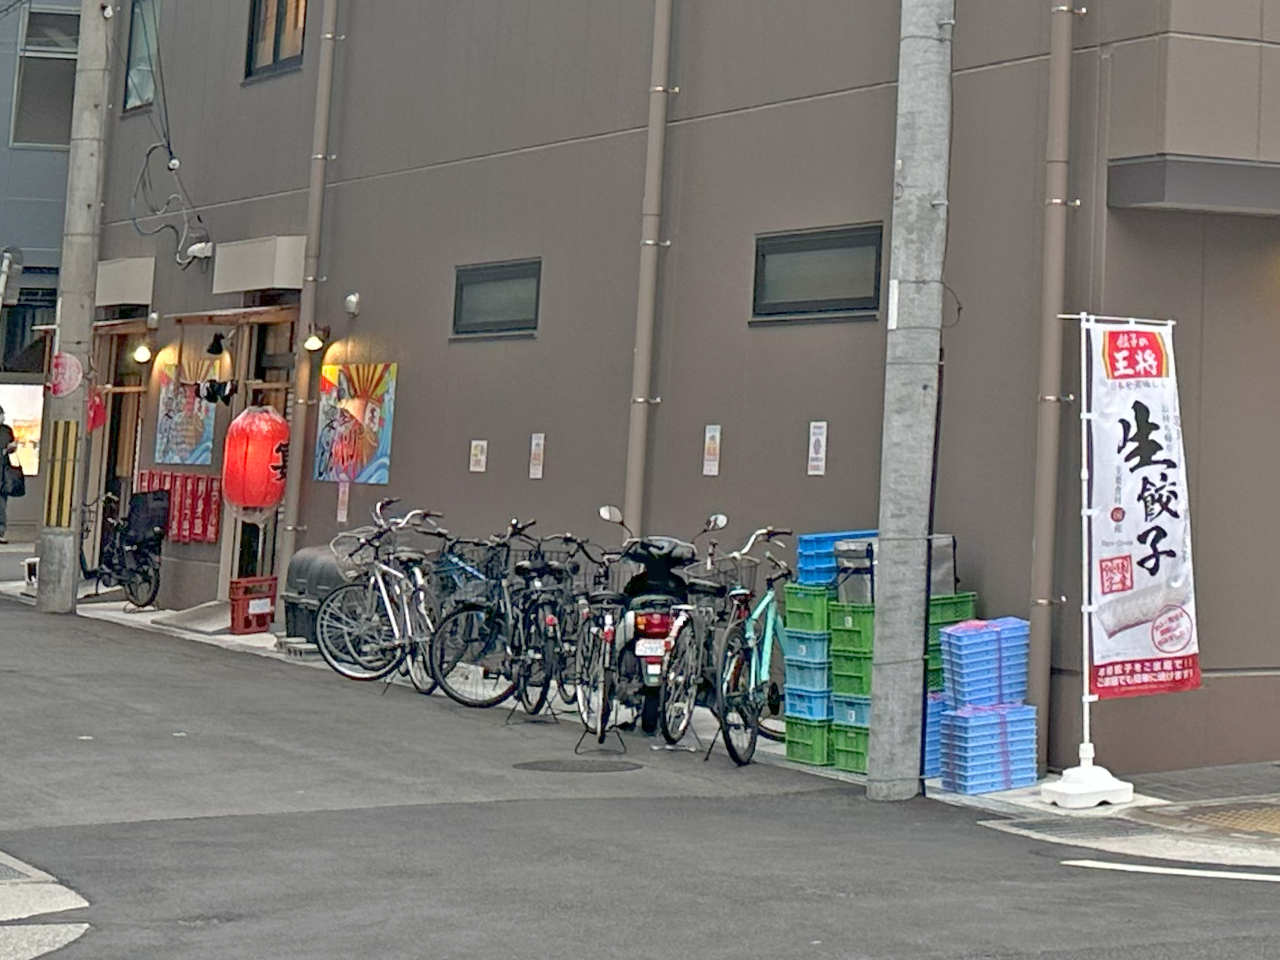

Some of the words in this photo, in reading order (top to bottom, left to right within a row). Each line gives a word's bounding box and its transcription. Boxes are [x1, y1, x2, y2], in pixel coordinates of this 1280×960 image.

[1113, 349, 1158, 377] 王将
[1117, 400, 1180, 576] 生餃子
